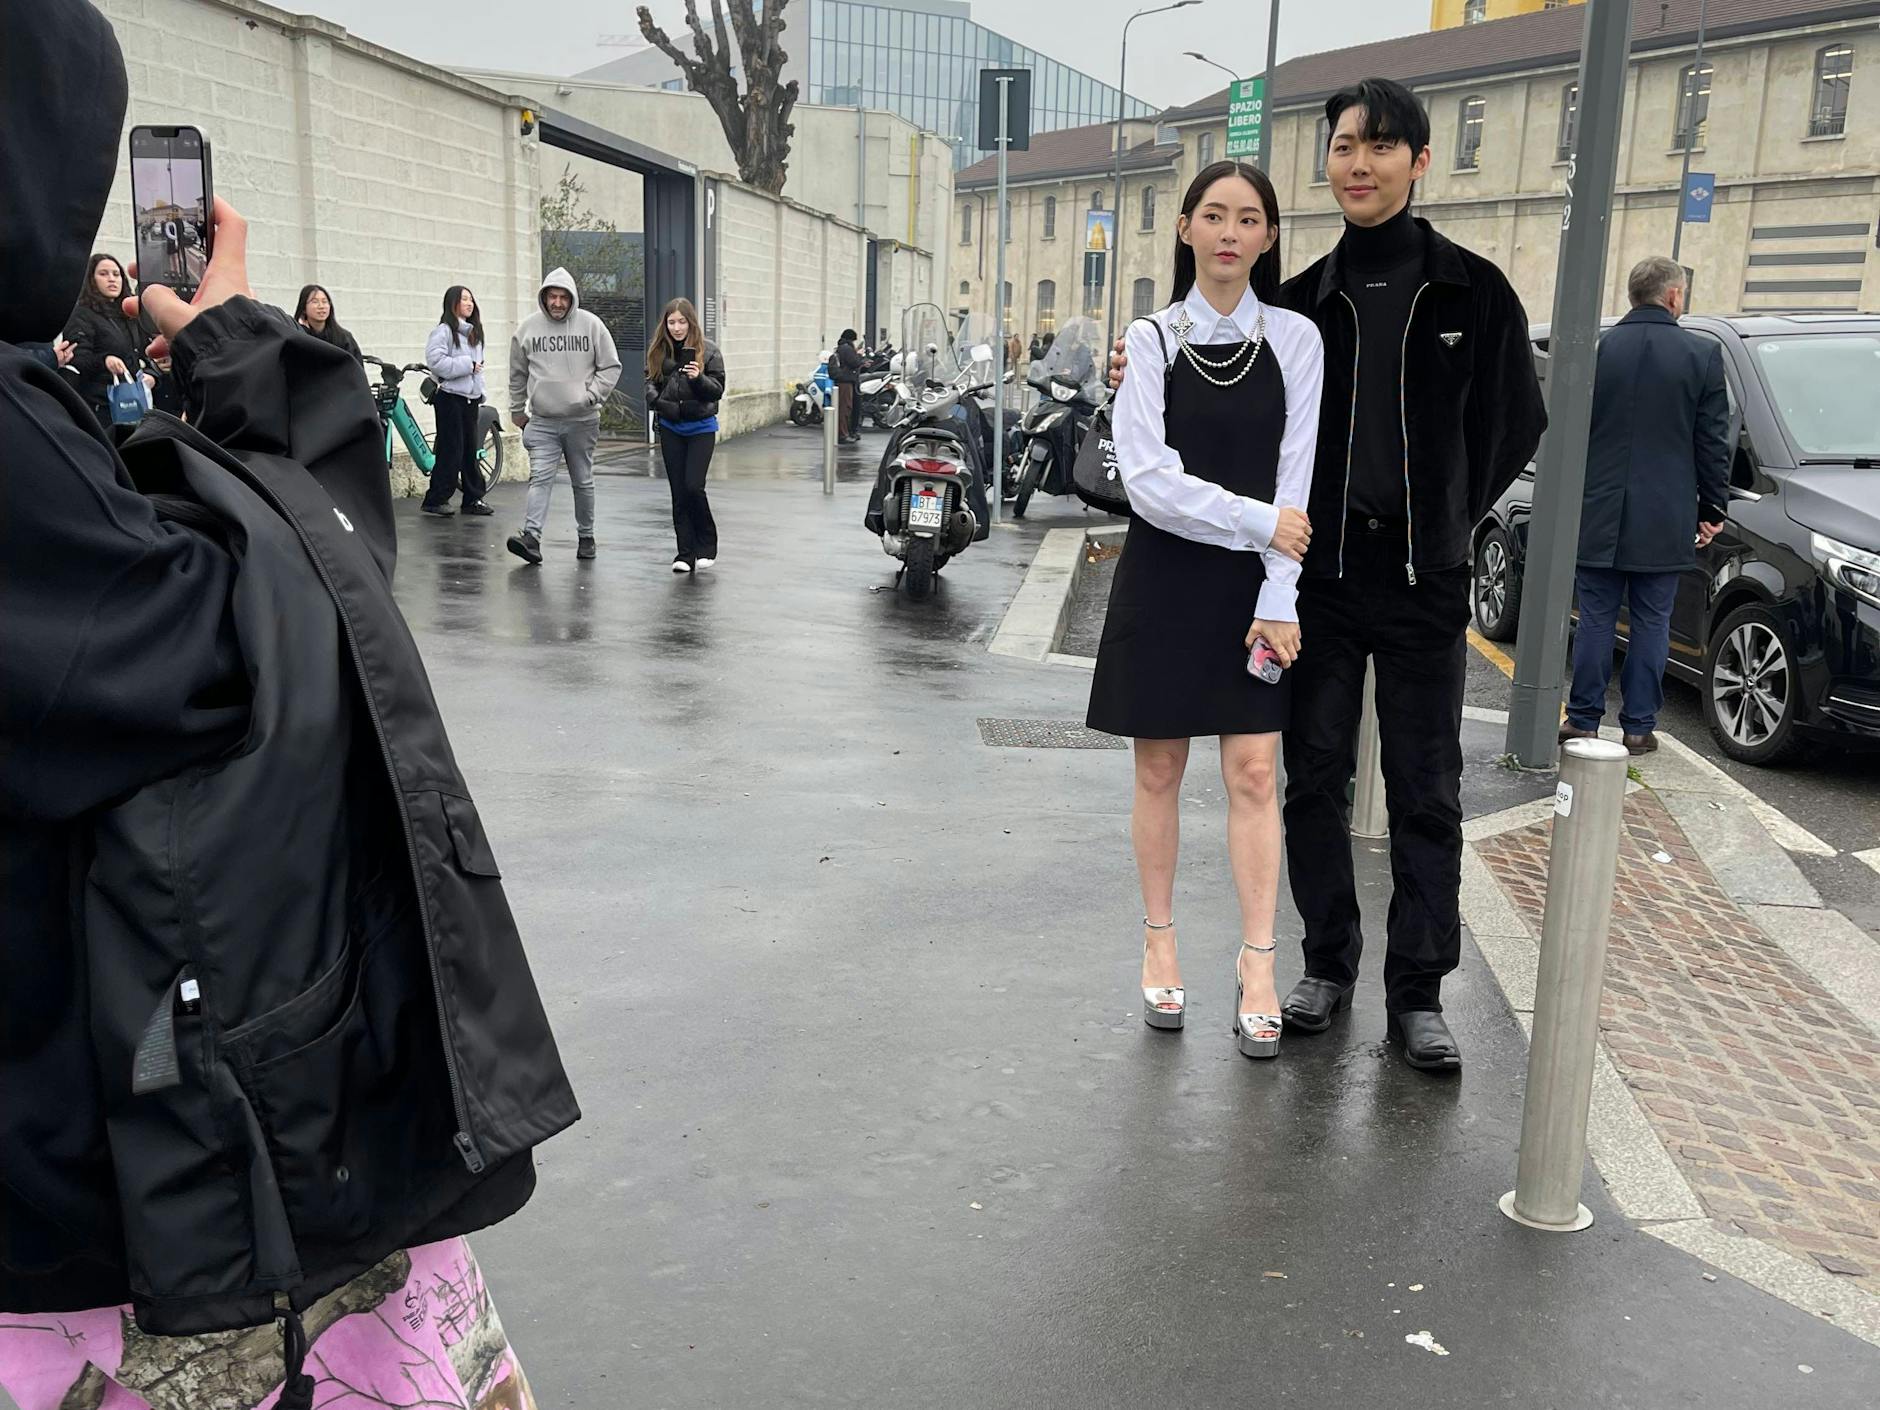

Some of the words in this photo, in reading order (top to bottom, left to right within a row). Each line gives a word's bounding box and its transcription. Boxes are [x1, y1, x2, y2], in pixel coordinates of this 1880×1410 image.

[1229, 99, 1263, 115] SPAZIO
[1228, 113, 1262, 128] LIBERO
[532, 335, 590, 353] MOSCHINO
[408, 418, 427, 456] TIER
[919, 496, 932, 508] BT
[911, 510, 941, 525] 67973
